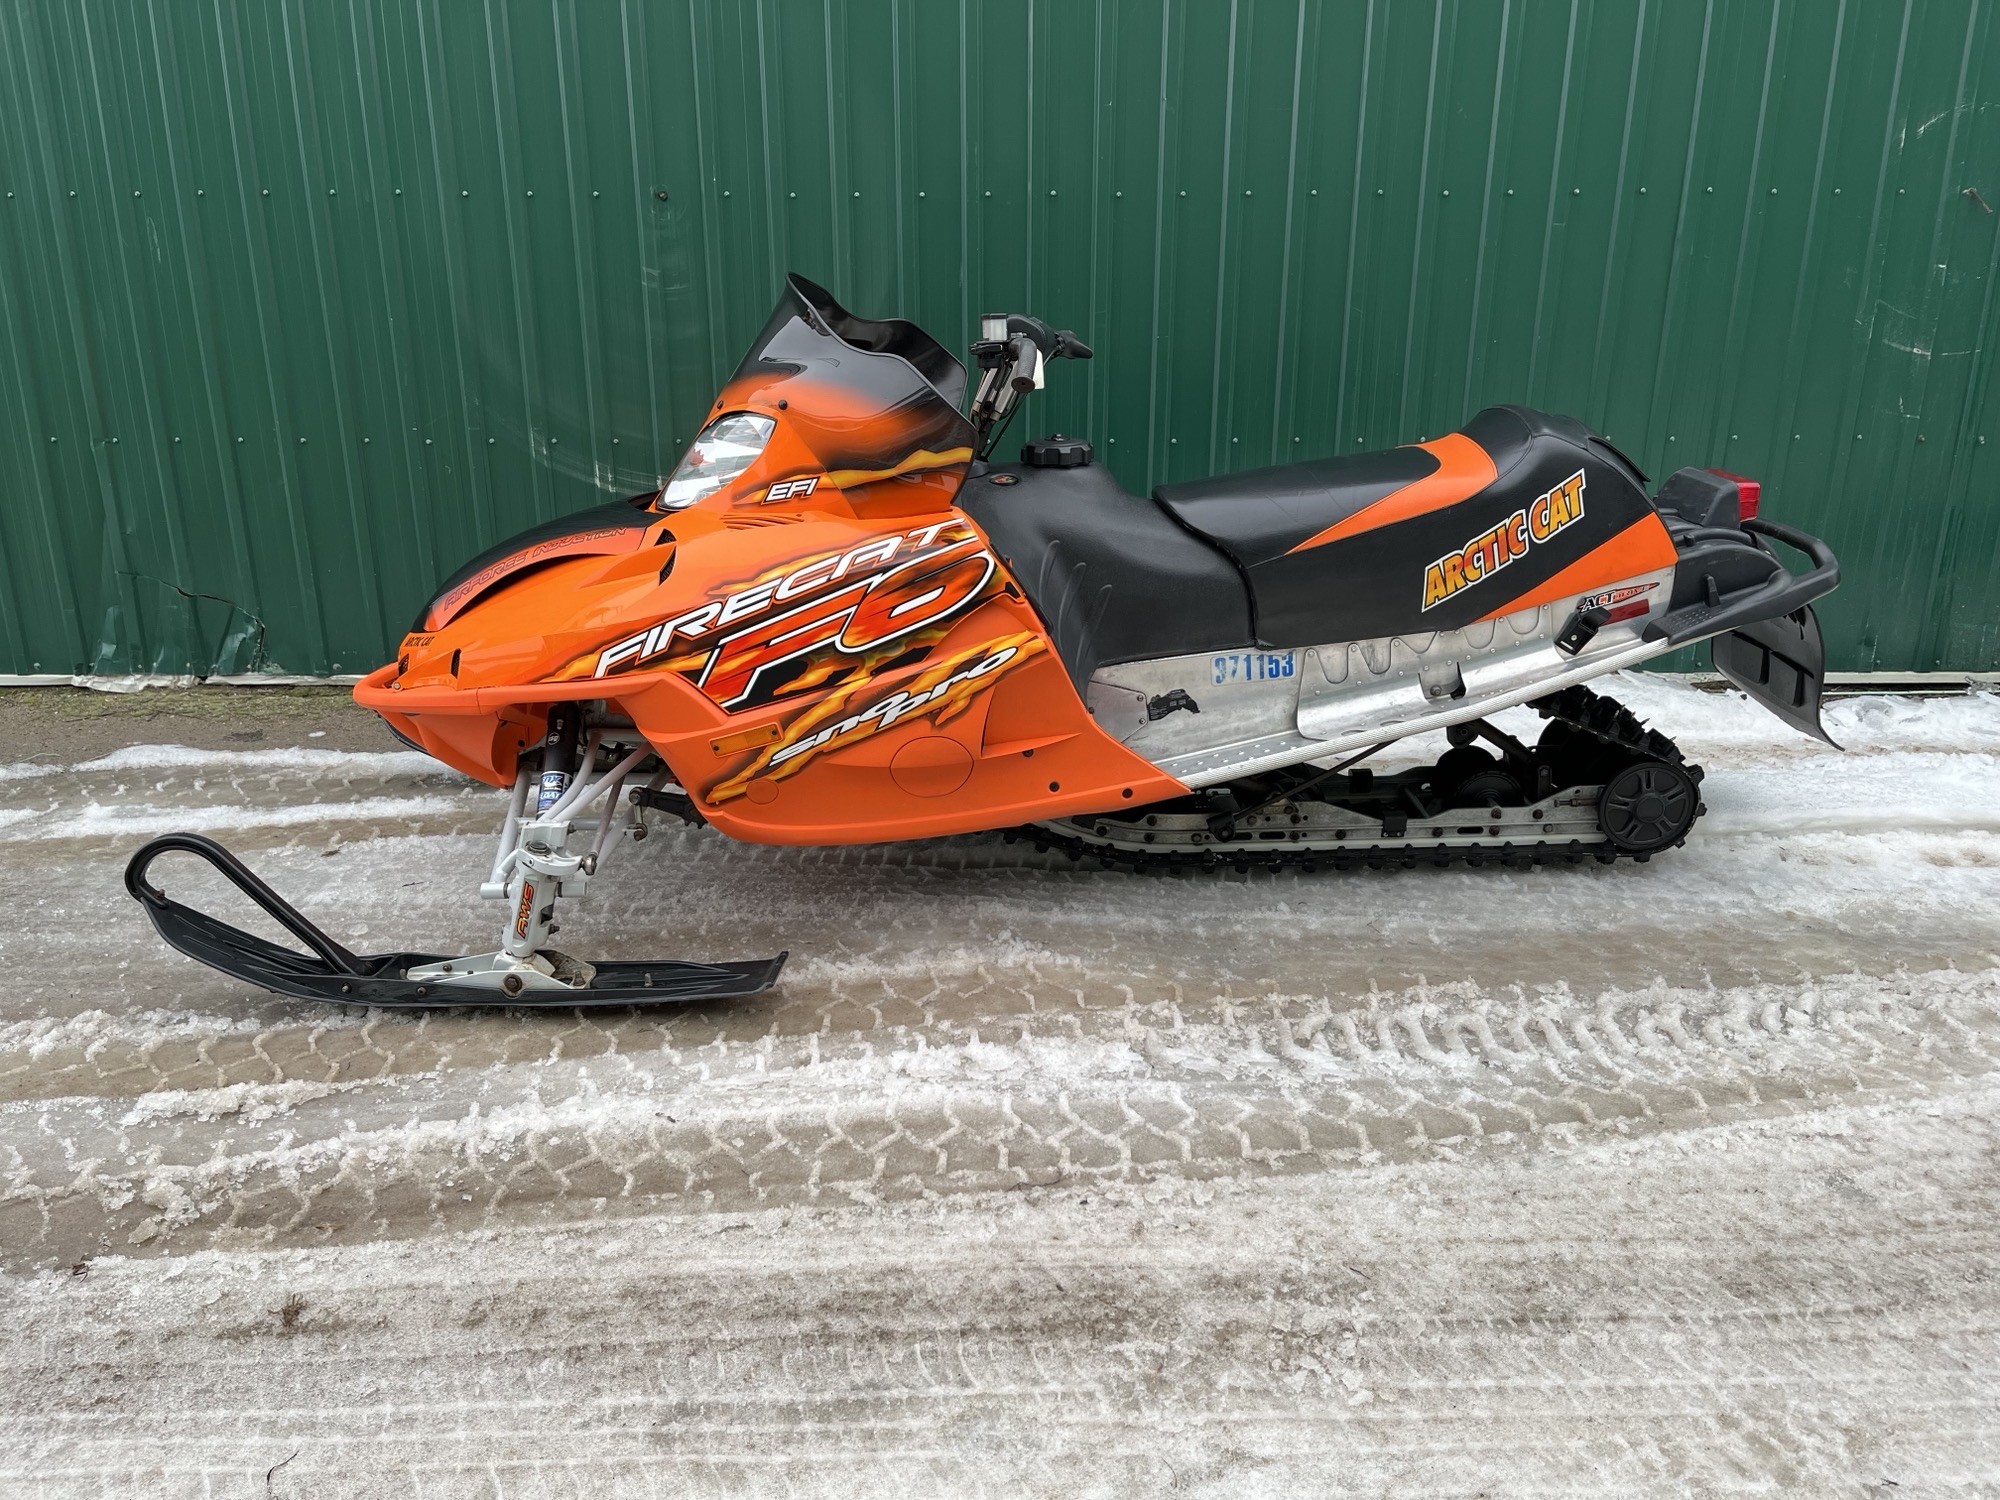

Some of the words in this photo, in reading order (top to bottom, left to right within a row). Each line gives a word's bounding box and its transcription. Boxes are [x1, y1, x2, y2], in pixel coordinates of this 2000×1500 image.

[763, 477, 820, 503] EFI
[443, 551, 529, 612] AIRFORCE
[531, 527, 627, 558] INDUCTION
[1422, 508, 1529, 613] ARCTIC
[1529, 467, 1586, 544] CAT
[593, 517, 965, 678] FIRECAT
[1580, 590, 1617, 613] ACT
[517, 881, 534, 939] AWS
